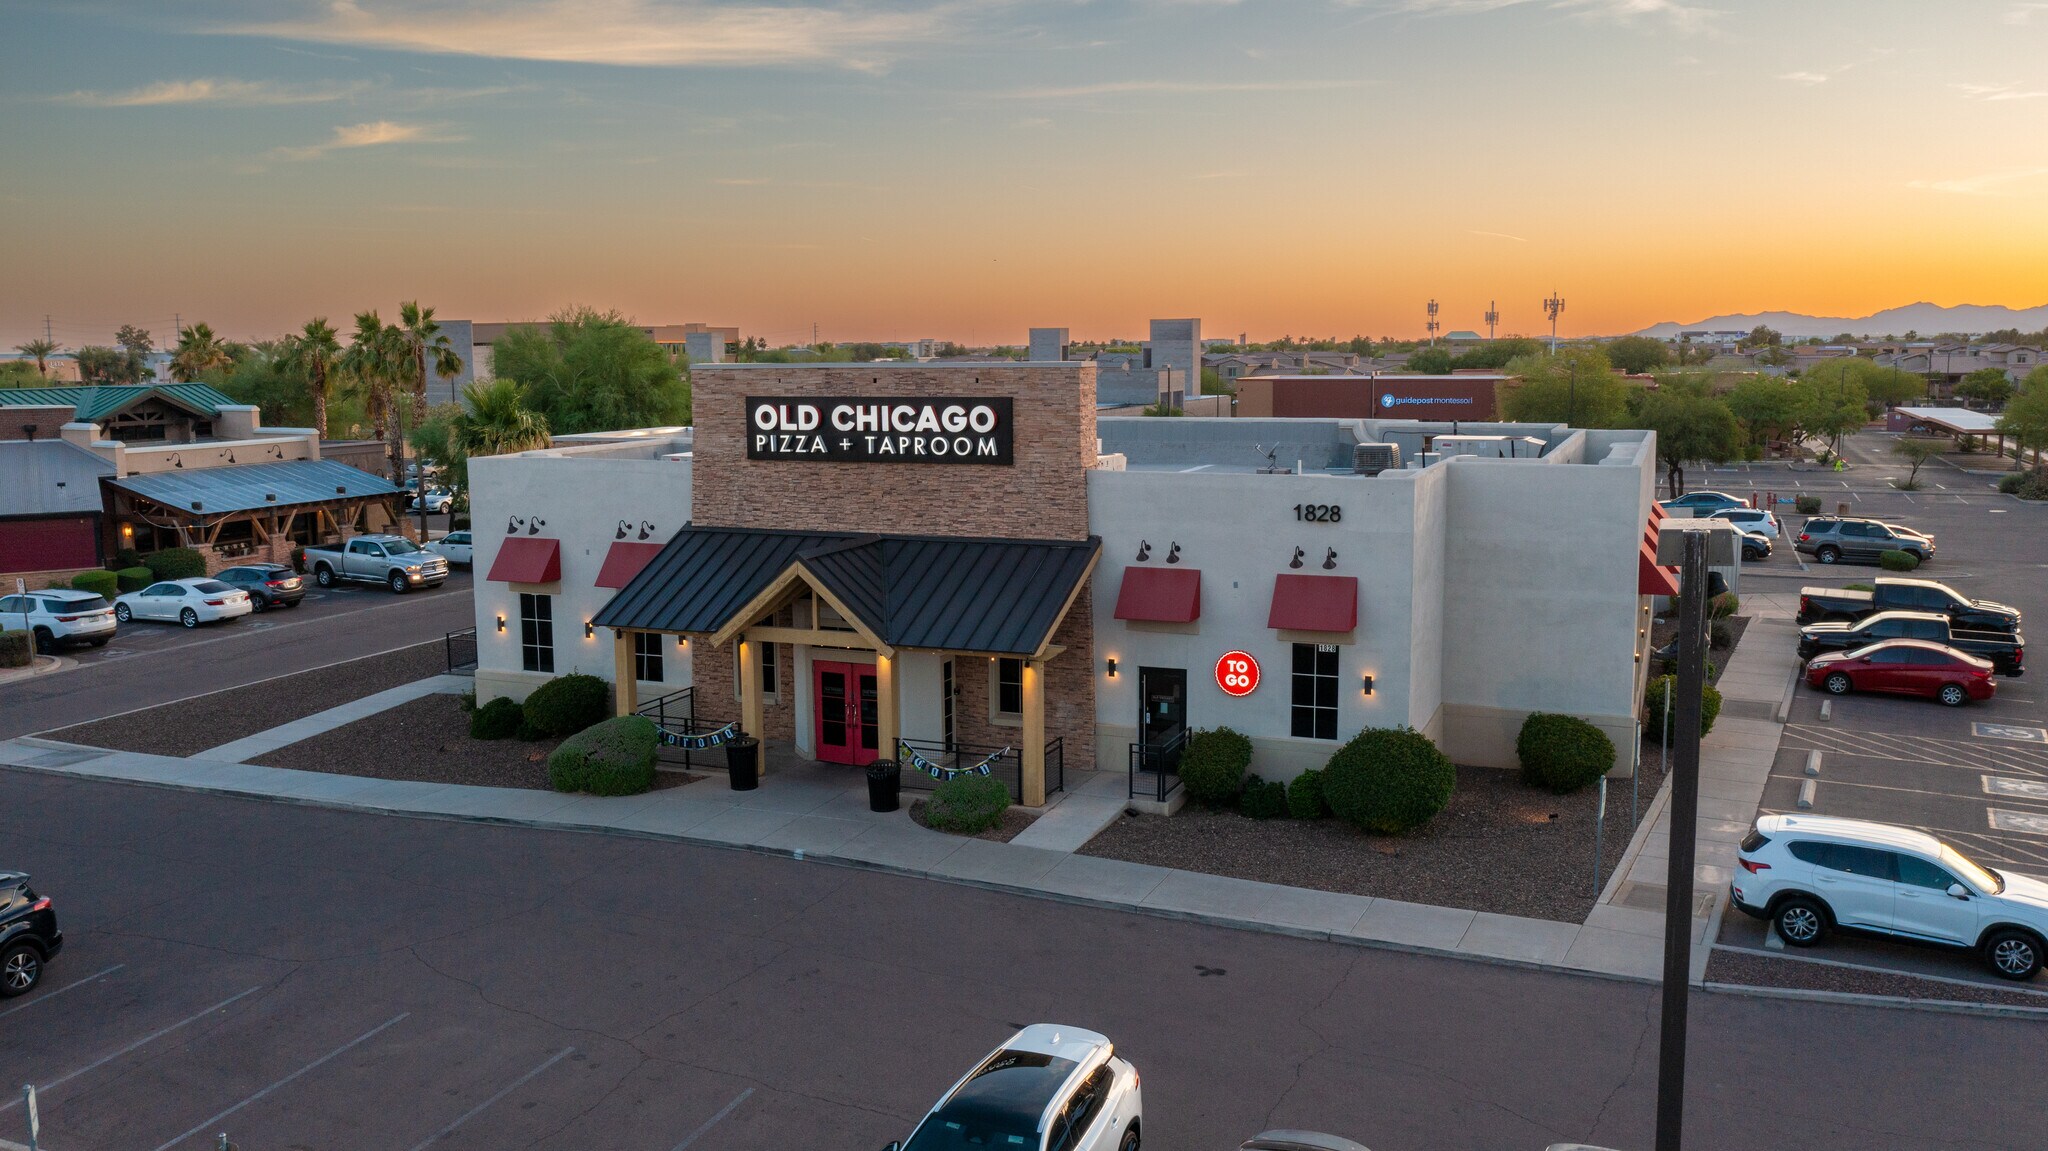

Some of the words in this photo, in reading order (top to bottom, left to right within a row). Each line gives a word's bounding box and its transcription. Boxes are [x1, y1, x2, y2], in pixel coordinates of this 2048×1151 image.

[1395, 397, 1433, 405] guidepost
[754, 404, 821, 431] OLD
[831, 404, 998, 433] CHICAGO
[756, 435, 827, 453] PIZZA
[864, 436, 998, 456] TAPROOM
[1293, 503, 1341, 522] 1828
[1318, 644, 1336, 652] 1828
[1227, 660, 1248, 673] TO
[1225, 674, 1249, 687] GO
[657, 728, 735, 748] orona
